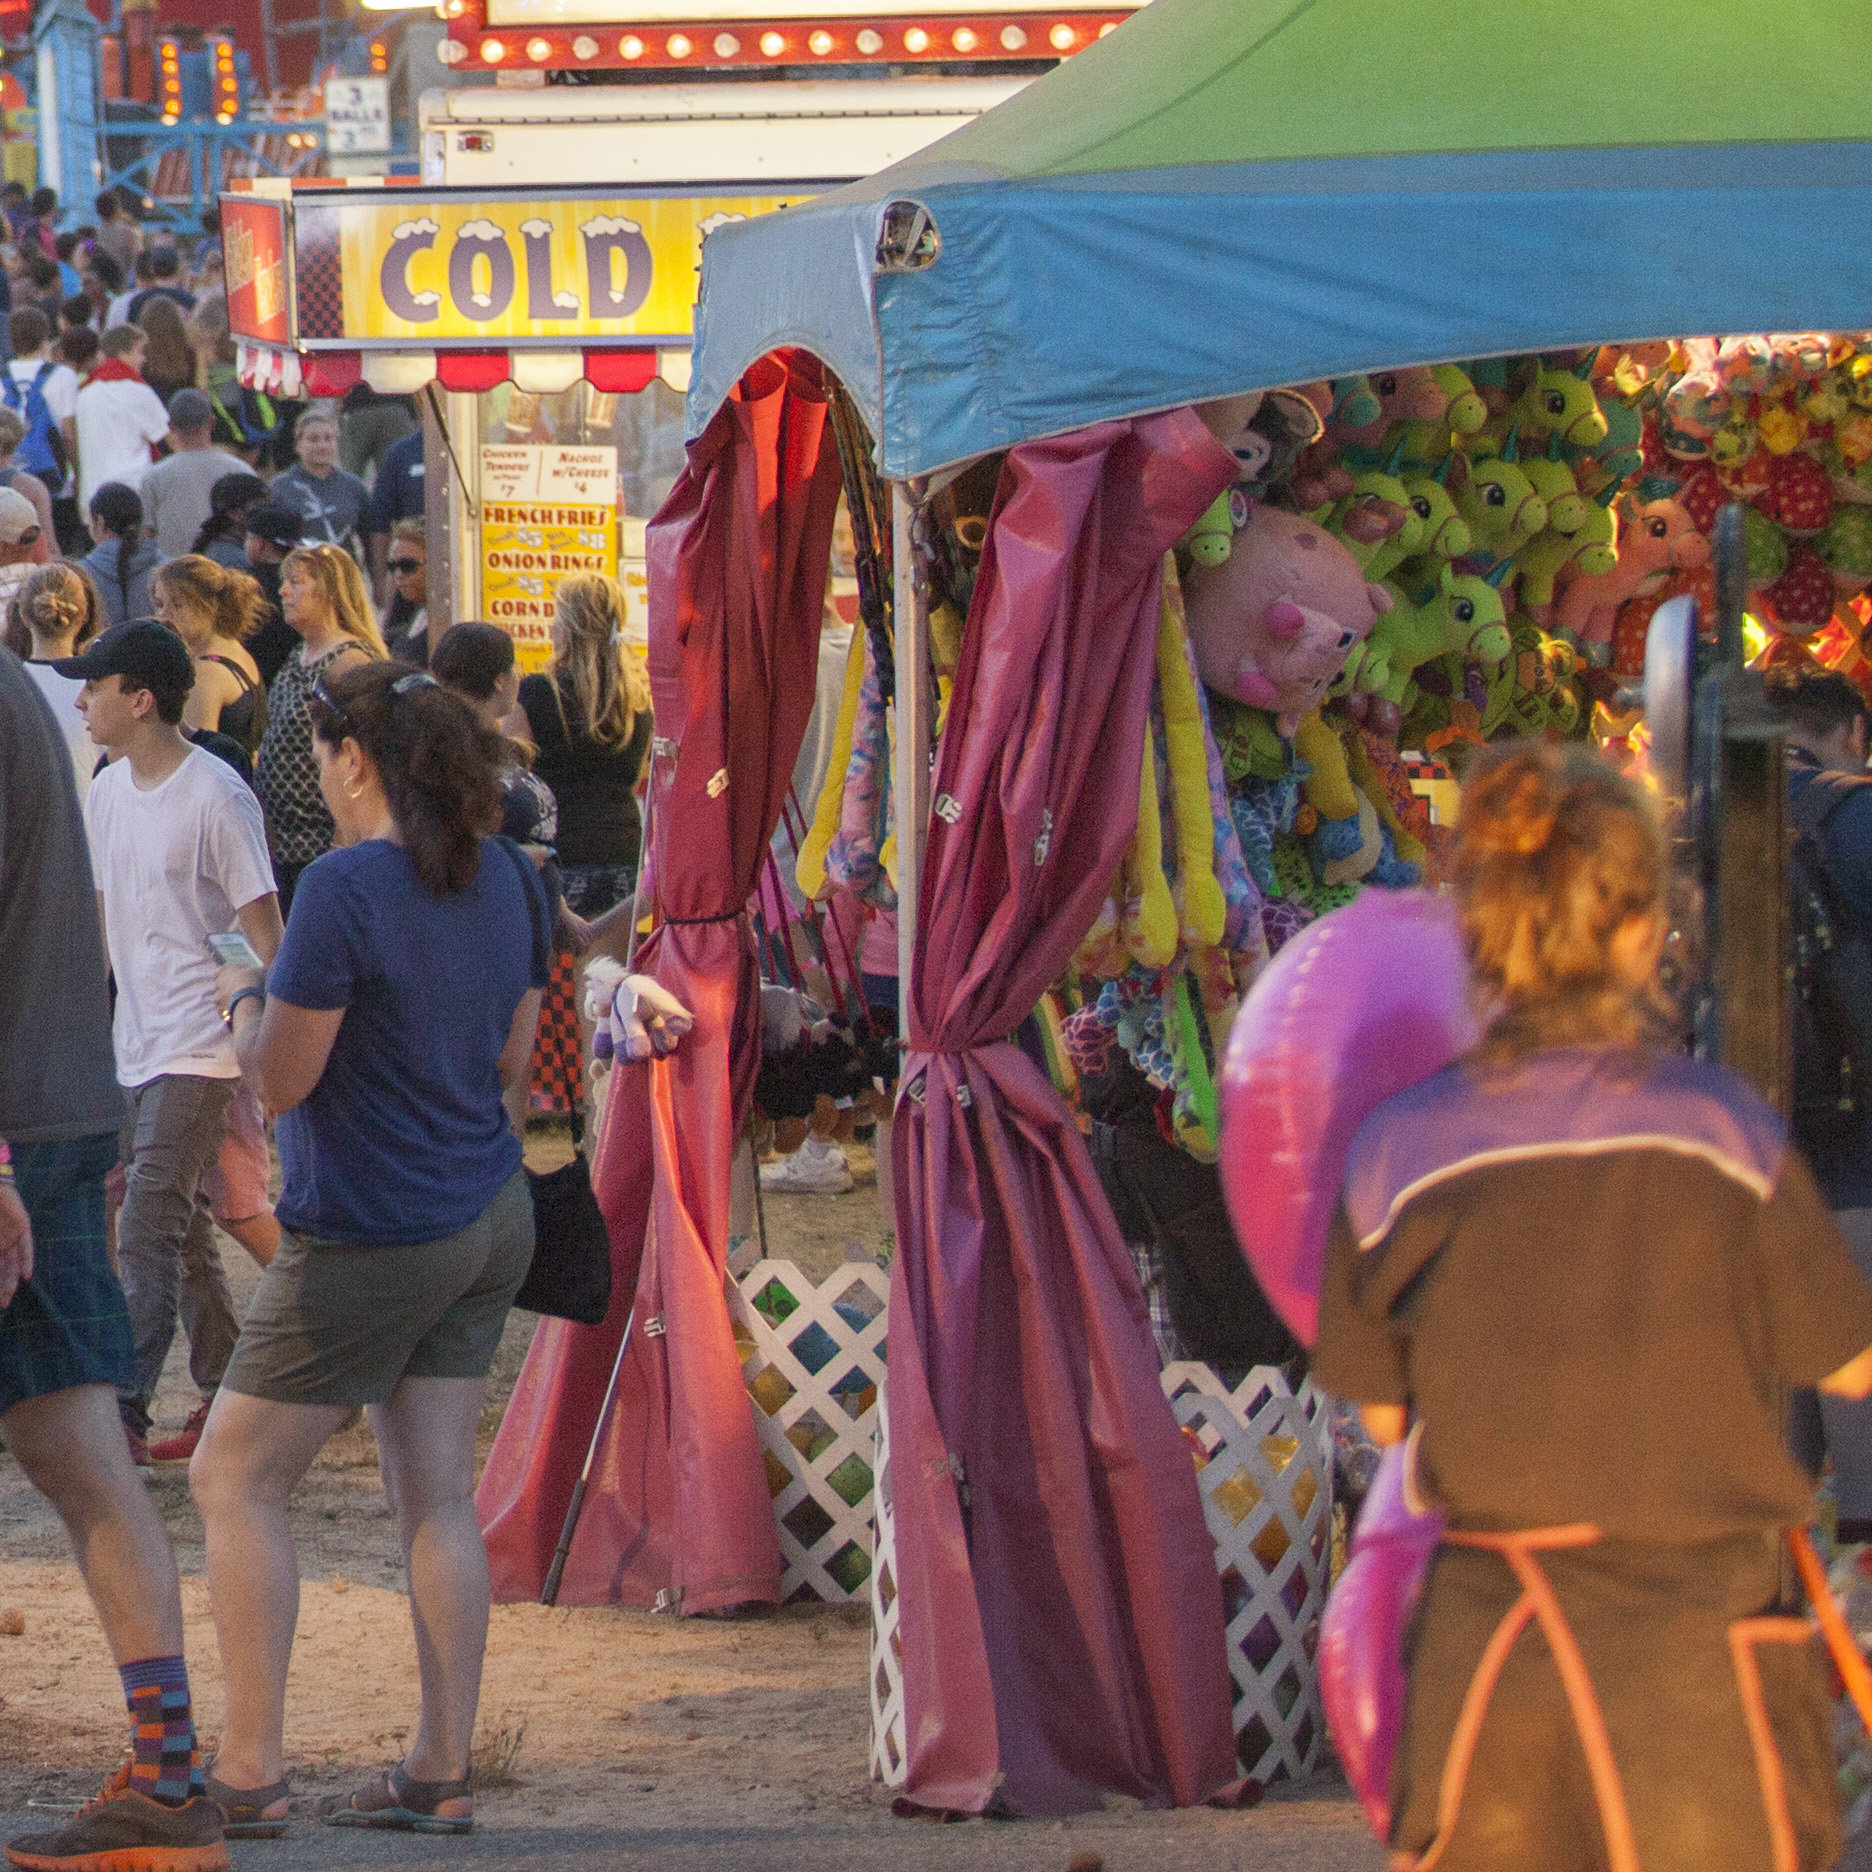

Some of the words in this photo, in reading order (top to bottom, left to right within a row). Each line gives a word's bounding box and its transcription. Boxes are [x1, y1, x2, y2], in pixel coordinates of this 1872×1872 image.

[379, 212, 654, 323] COLD
[484, 507, 553, 523] FRENCH
[557, 509, 606, 525] FRIES
[488, 553, 546, 568] ONION
[551, 555, 603, 569] RINGS
[491, 600, 539, 616] CORN
